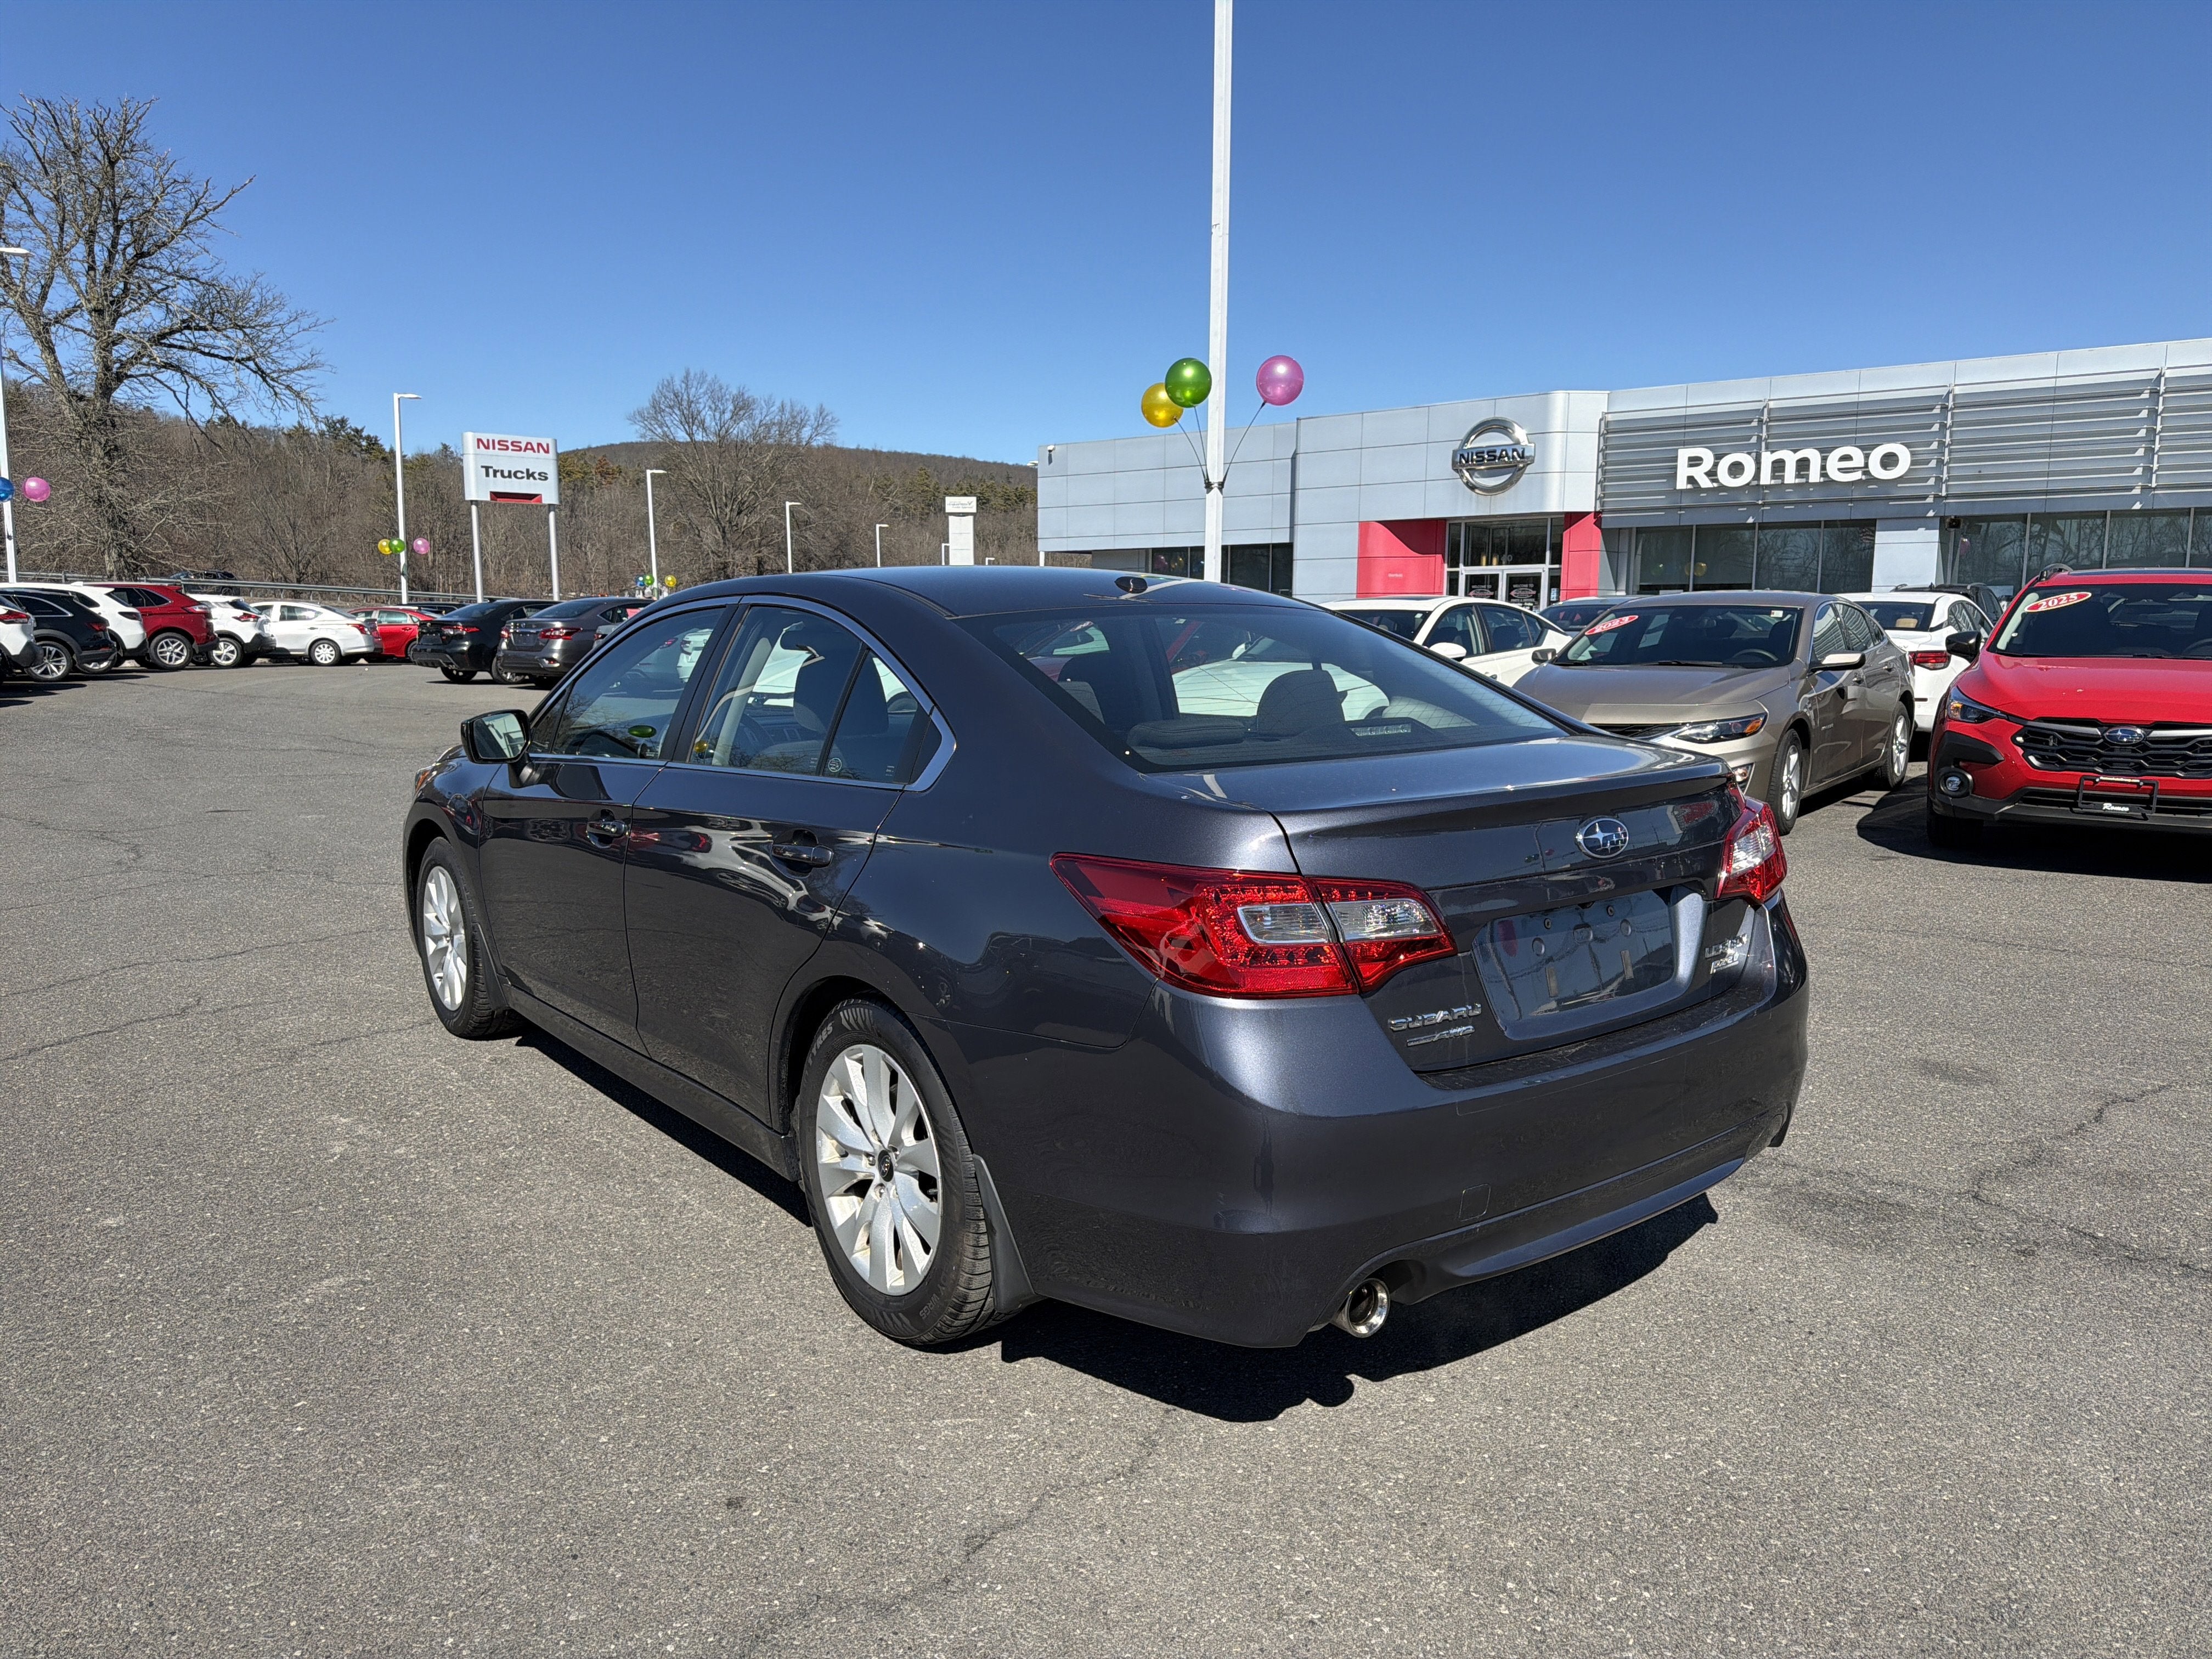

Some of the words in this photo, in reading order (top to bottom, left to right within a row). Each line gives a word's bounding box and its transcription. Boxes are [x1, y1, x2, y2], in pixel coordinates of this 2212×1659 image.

[477, 438, 550, 454] NISSAN
[1459, 448, 1525, 465] NISSAN
[481, 465, 549, 481] Trucks
[1677, 443, 1911, 489] Romeo
[2038, 594, 2078, 610] 2025
[2103, 803, 2129, 811] Romeo
[1390, 1003, 1481, 1031] SUBARU
